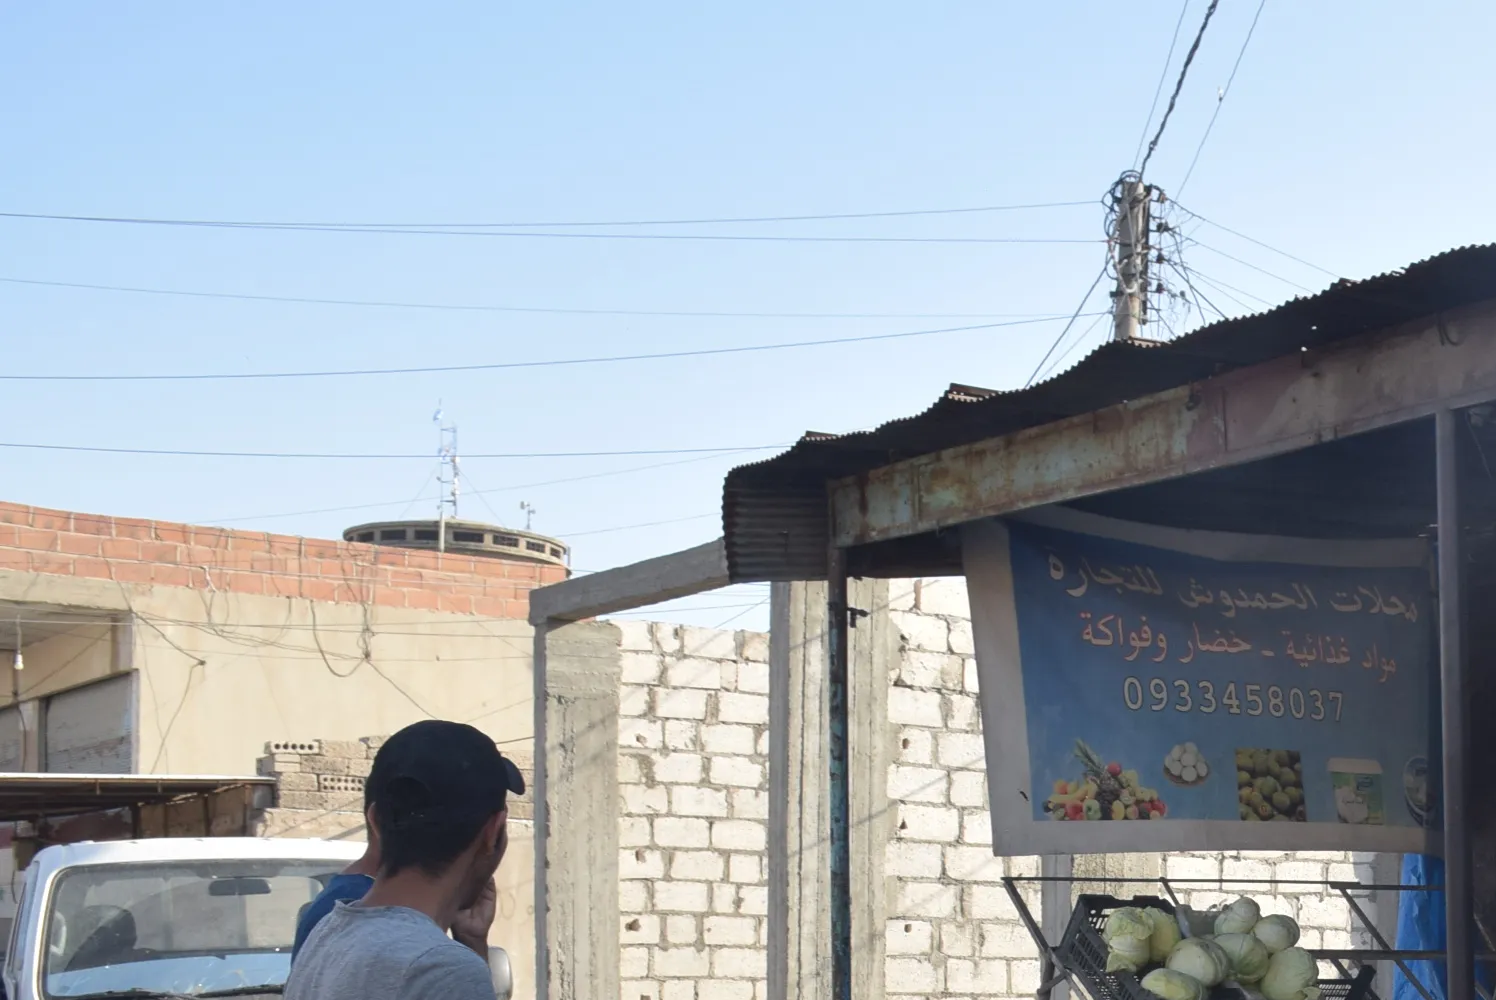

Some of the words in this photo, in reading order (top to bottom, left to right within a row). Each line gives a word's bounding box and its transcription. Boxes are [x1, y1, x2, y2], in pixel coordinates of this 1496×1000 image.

[1328, 584, 1419, 623] محلات
[1079, 611, 1168, 662] وفواكة
[1178, 621, 1252, 664] خضار
[1281, 629, 1351, 668] غذائية
[1361, 642, 1397, 683] مواد
[1122, 675, 1344, 722] 0933458037
